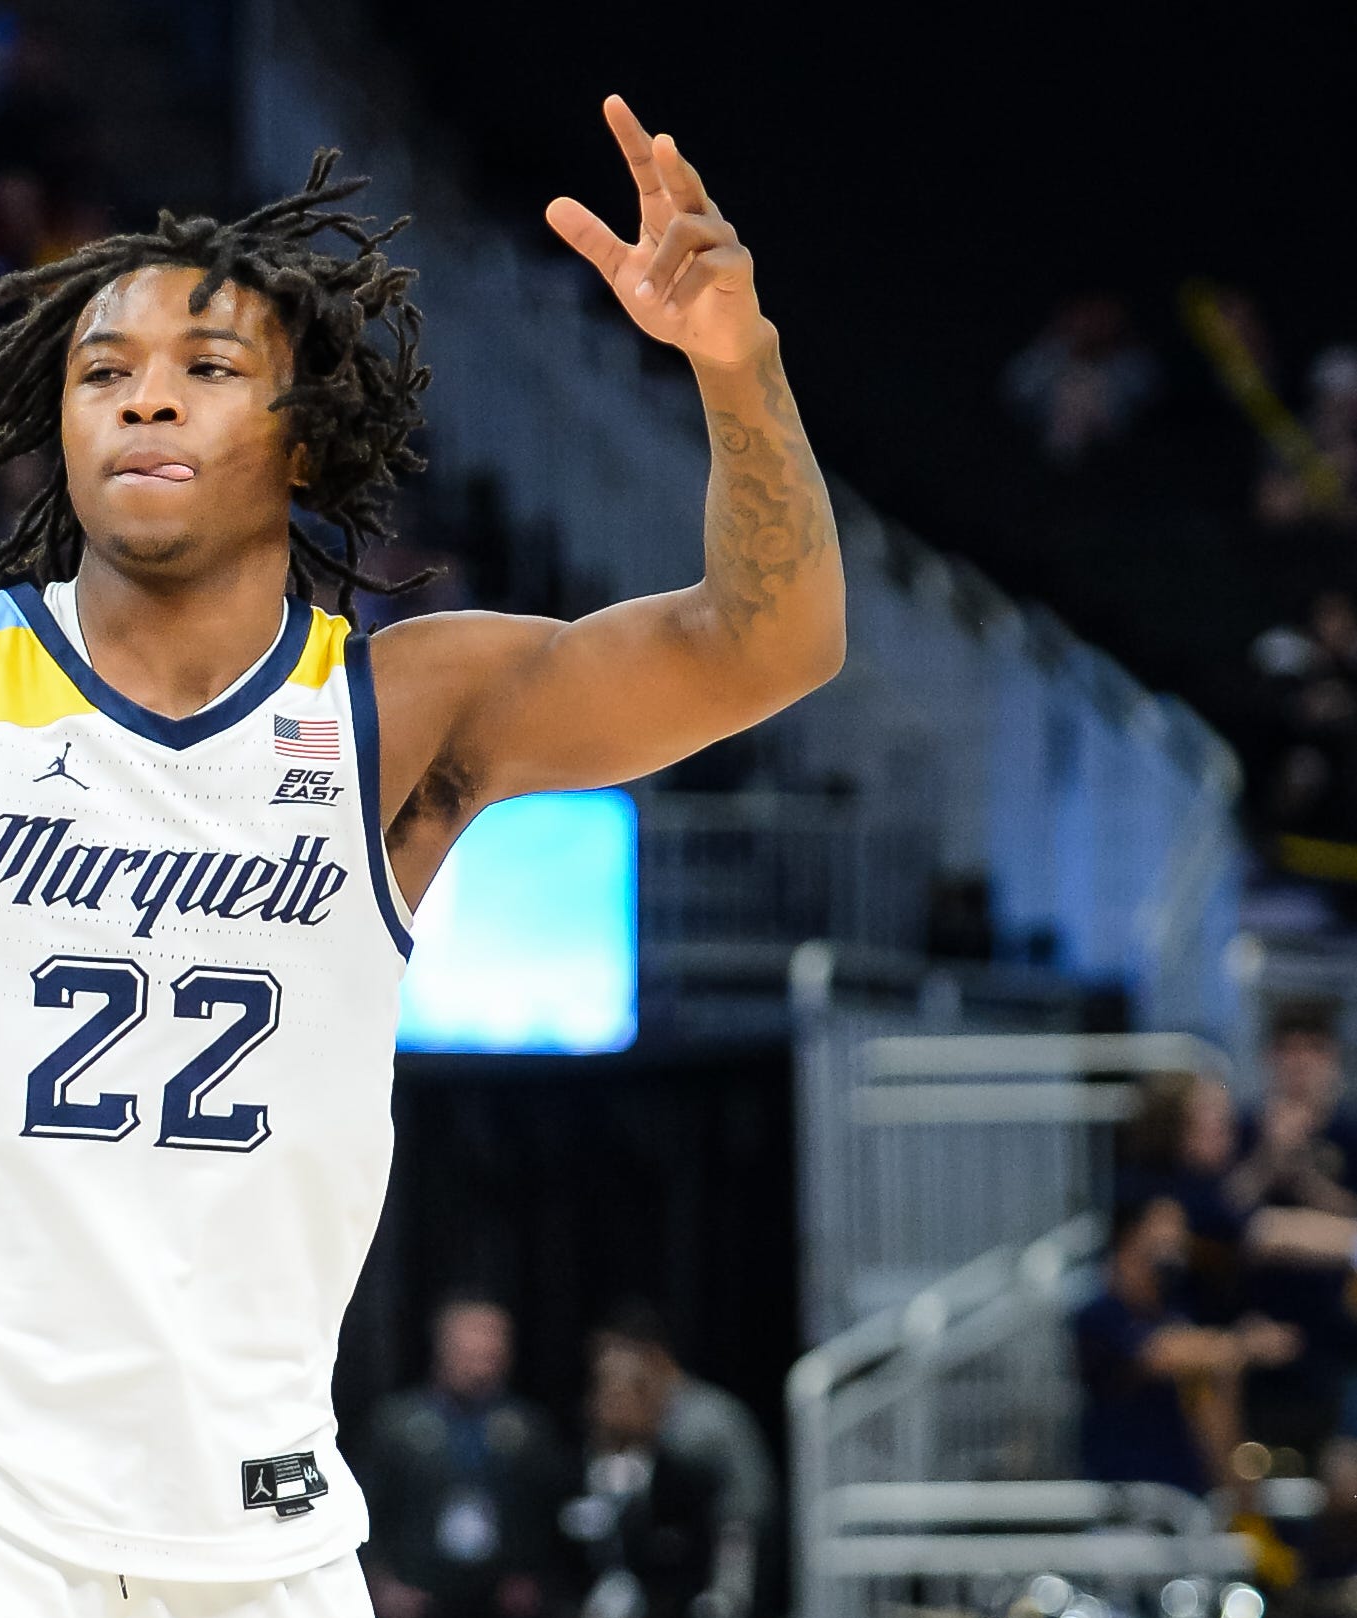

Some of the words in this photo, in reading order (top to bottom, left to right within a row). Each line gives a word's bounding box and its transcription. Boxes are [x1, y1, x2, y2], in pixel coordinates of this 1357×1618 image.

[282, 768, 334, 785] BIG
[274, 783, 345, 801] EAST
[18, 953, 283, 1154] 22
